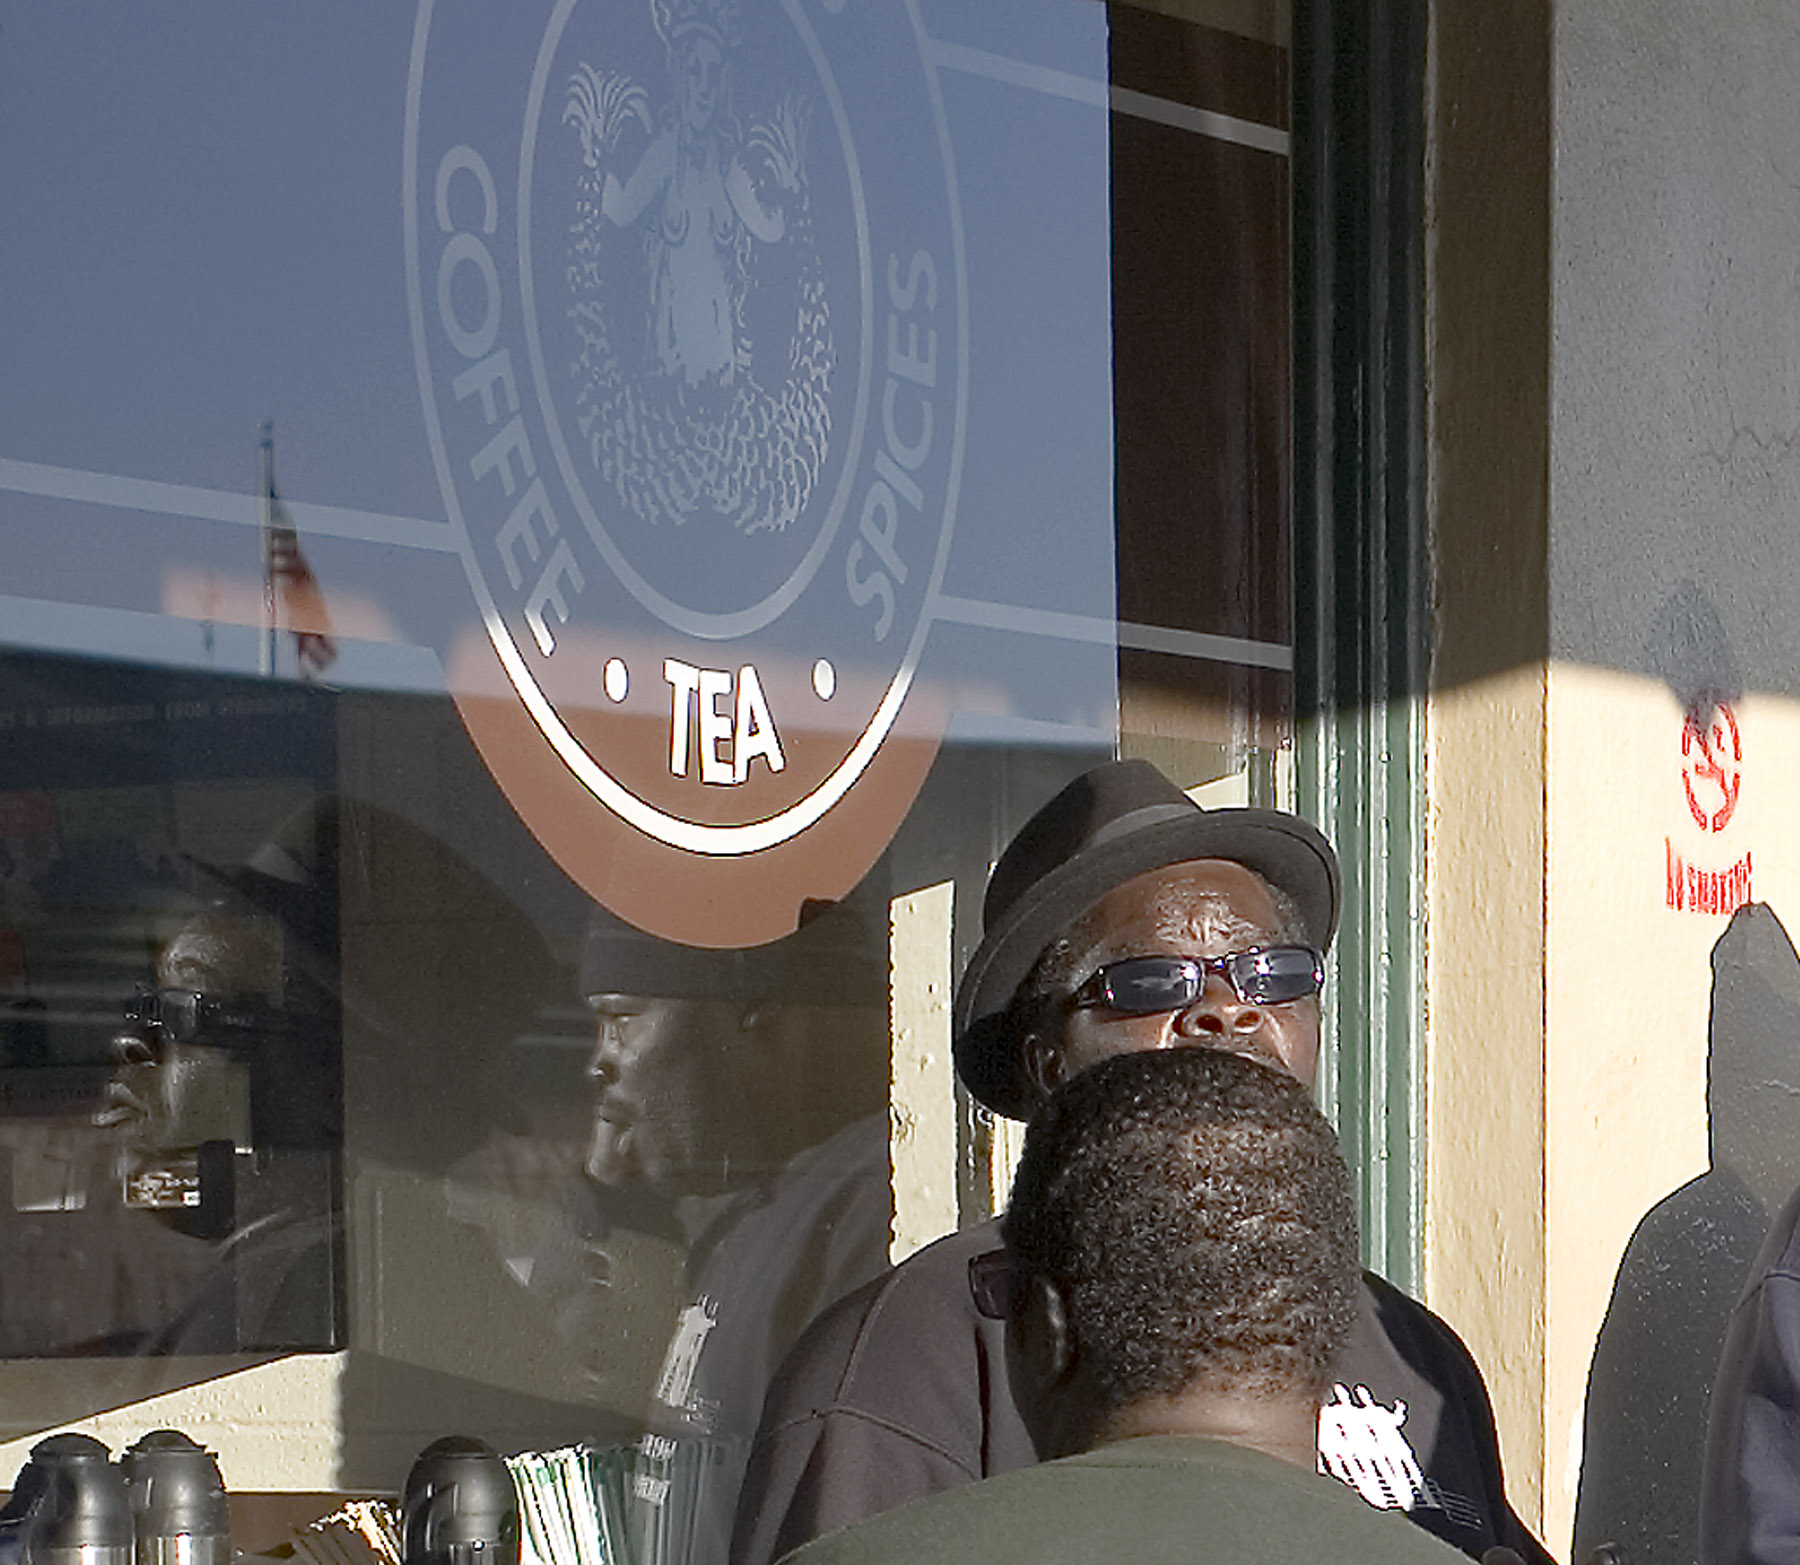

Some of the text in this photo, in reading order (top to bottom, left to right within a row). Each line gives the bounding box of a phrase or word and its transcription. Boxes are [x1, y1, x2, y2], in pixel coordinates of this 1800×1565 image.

[435, 143, 938, 787] COFFEE TEA SPICES
